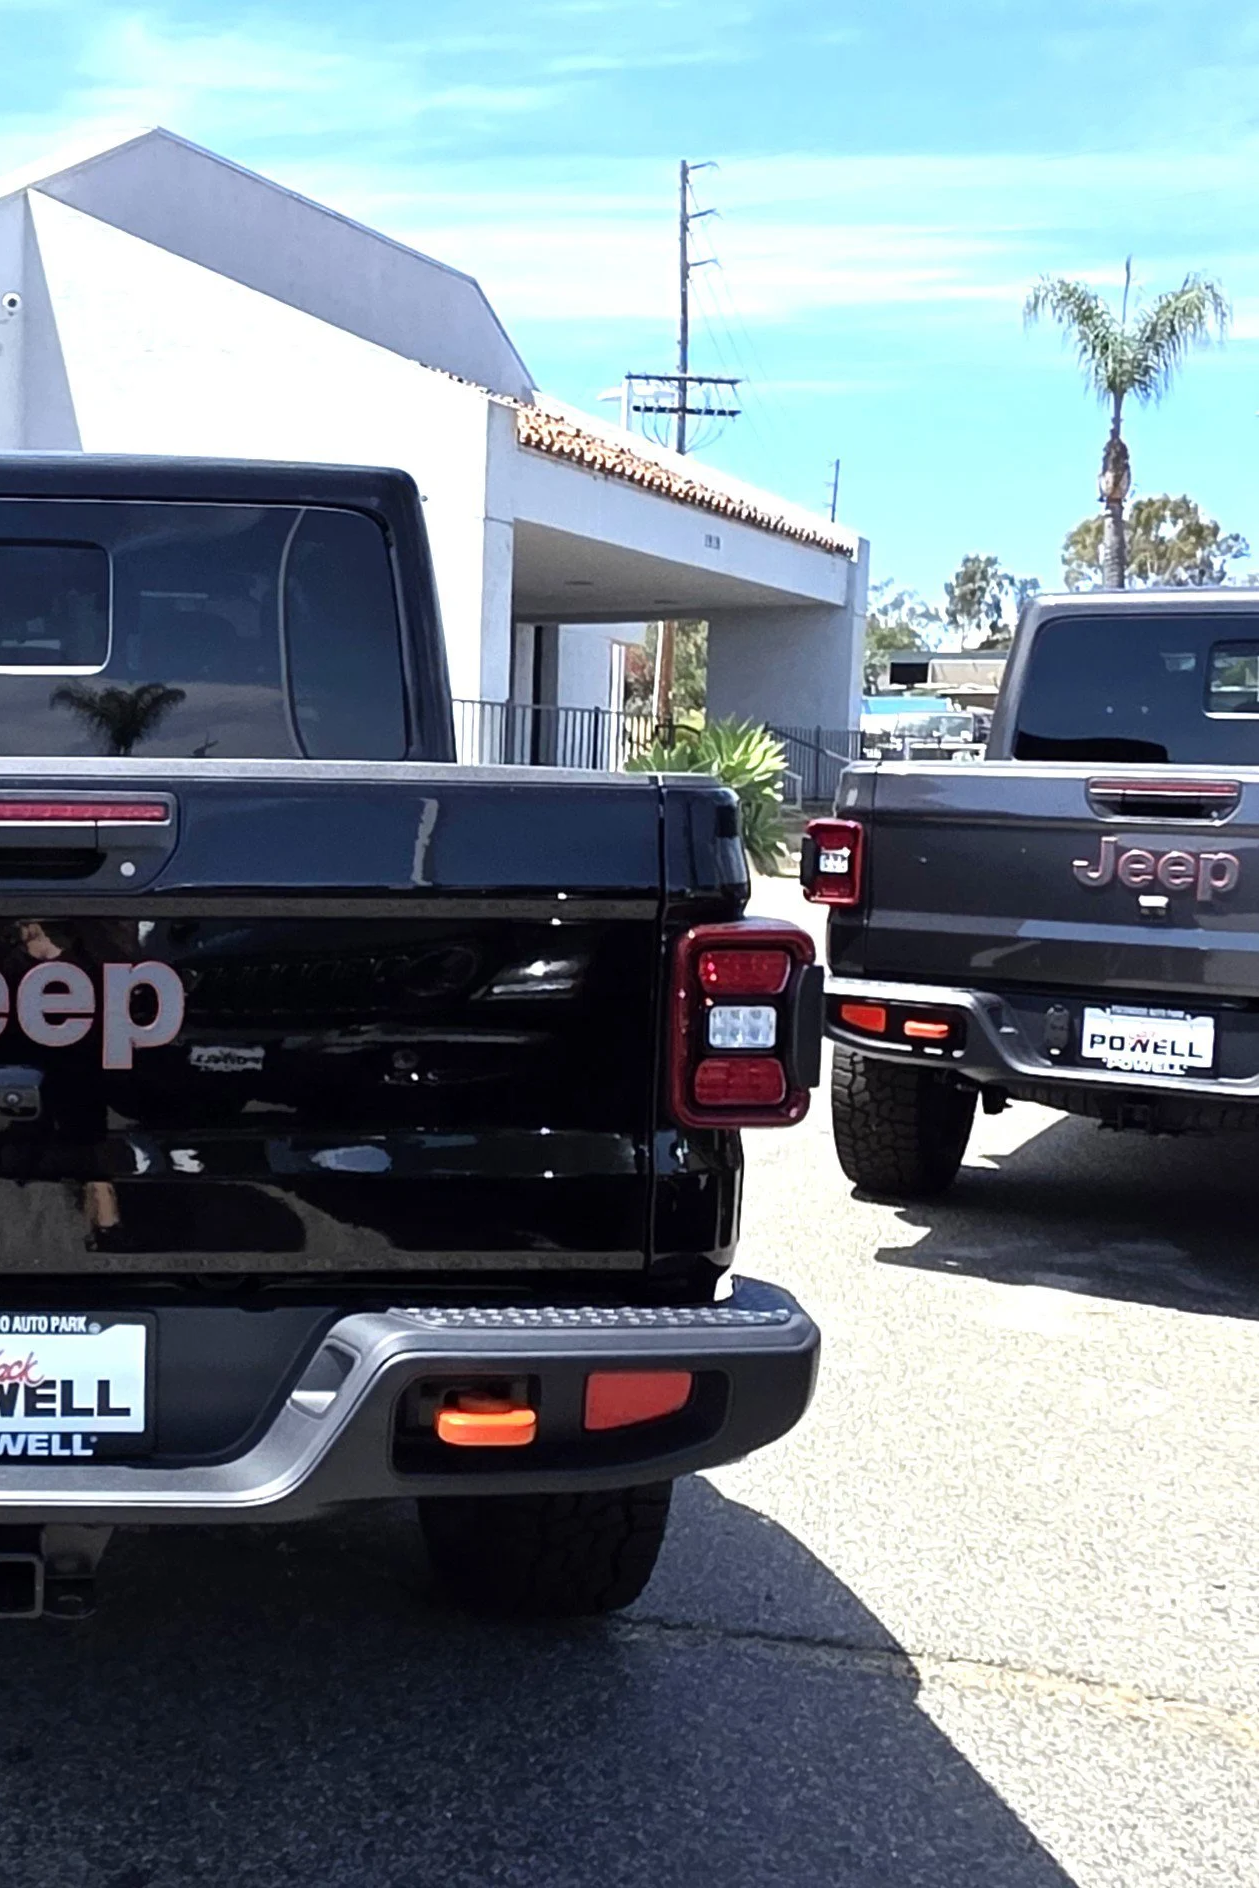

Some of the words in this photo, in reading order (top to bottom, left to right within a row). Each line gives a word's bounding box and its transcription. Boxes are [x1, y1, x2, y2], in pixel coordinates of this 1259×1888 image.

[1072, 836, 1240, 903] Jeep
[1089, 1033, 1203, 1059] POWELL
[12, 1316, 48, 1333] AUTO
[50, 1316, 87, 1333] PARK
